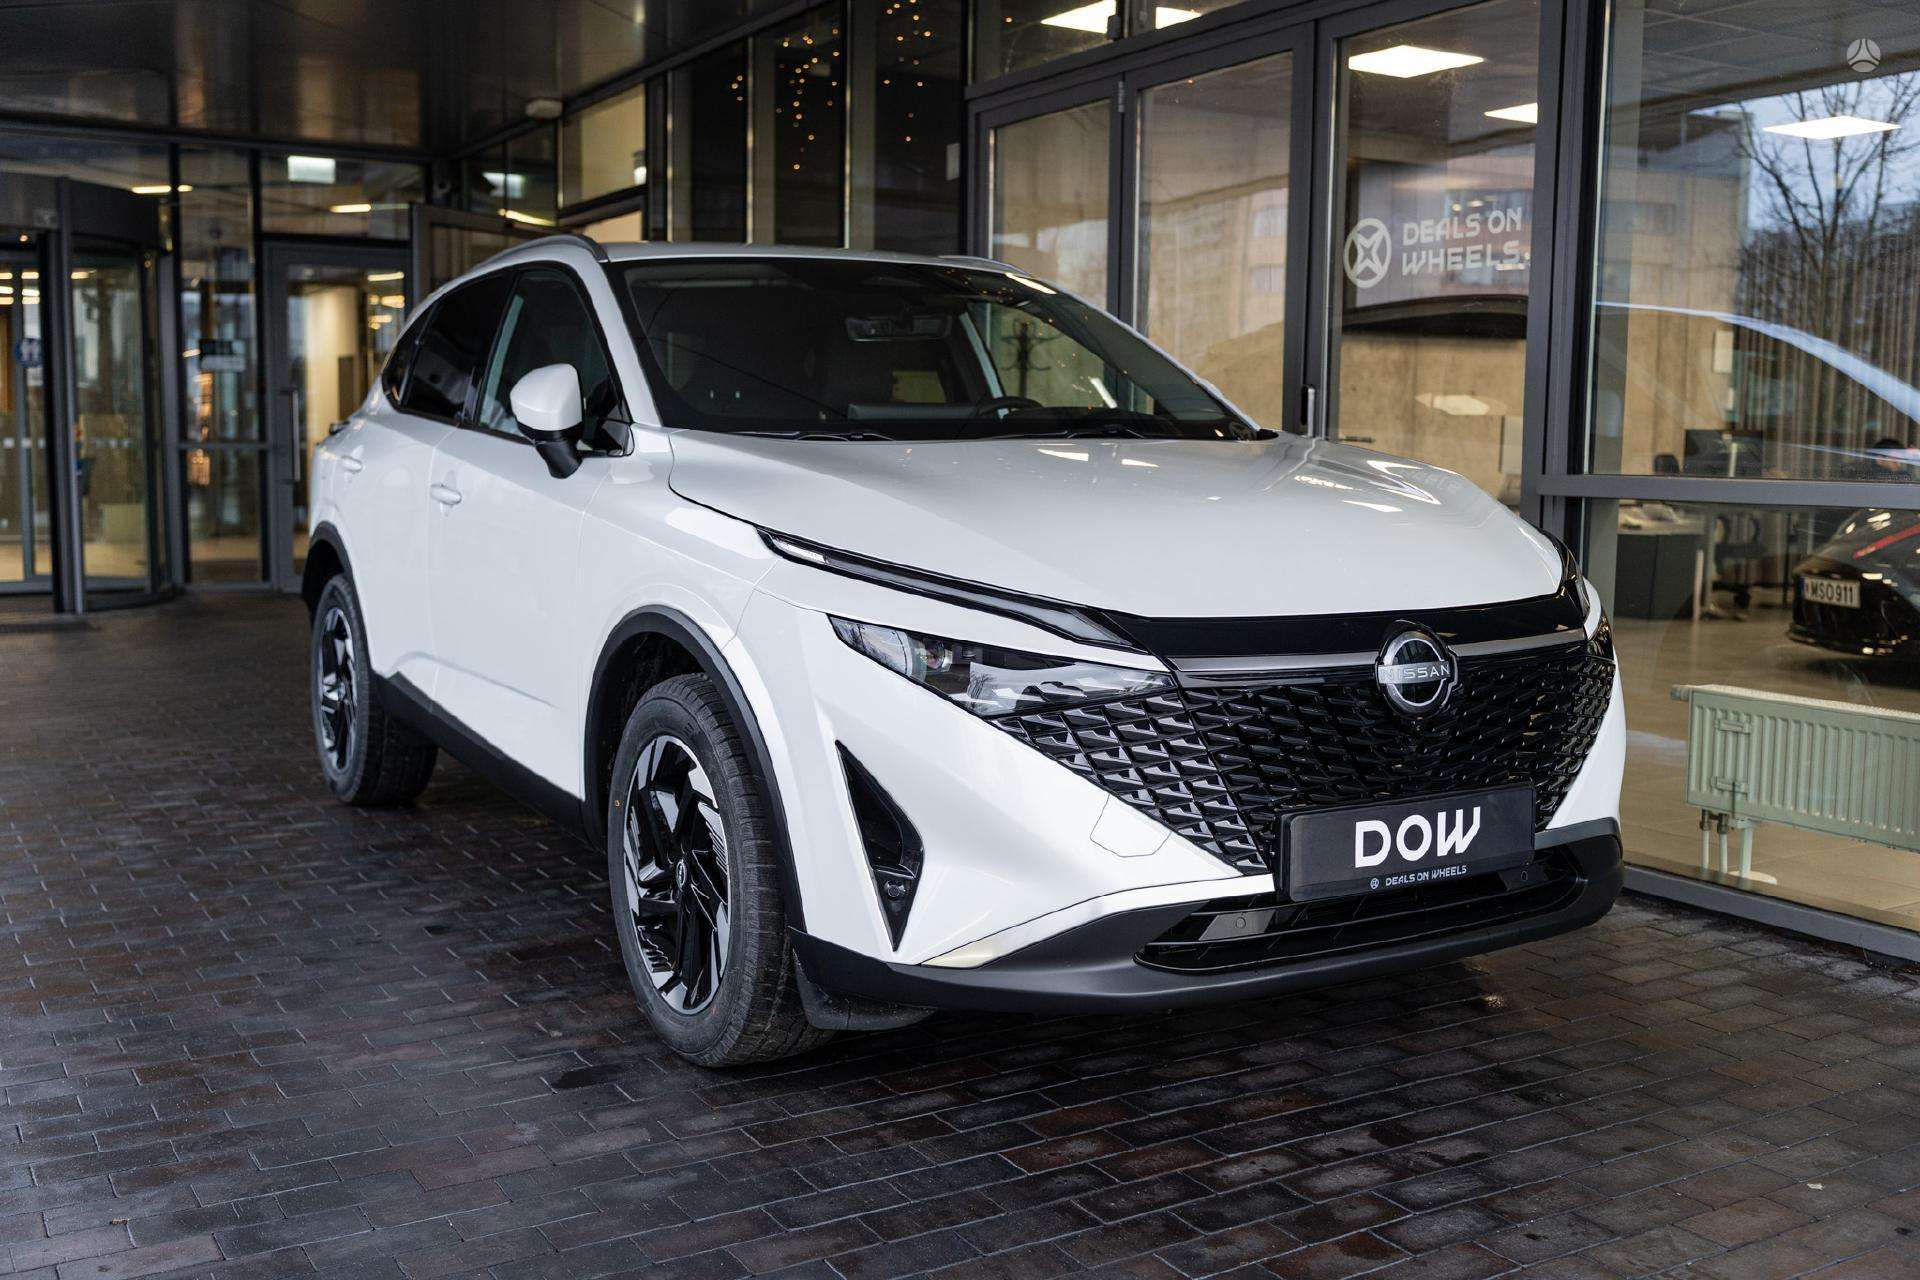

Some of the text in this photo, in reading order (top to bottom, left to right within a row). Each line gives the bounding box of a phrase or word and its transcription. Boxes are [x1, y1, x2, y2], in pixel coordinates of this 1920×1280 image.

[1402, 207, 1522, 246] DEALS ON
[1401, 240, 1520, 277] WHEELS
[1381, 664, 1451, 681] NISSAN
[1354, 806, 1481, 868] DOW
[1385, 865, 1467, 887] DEALS ON WHEELS
